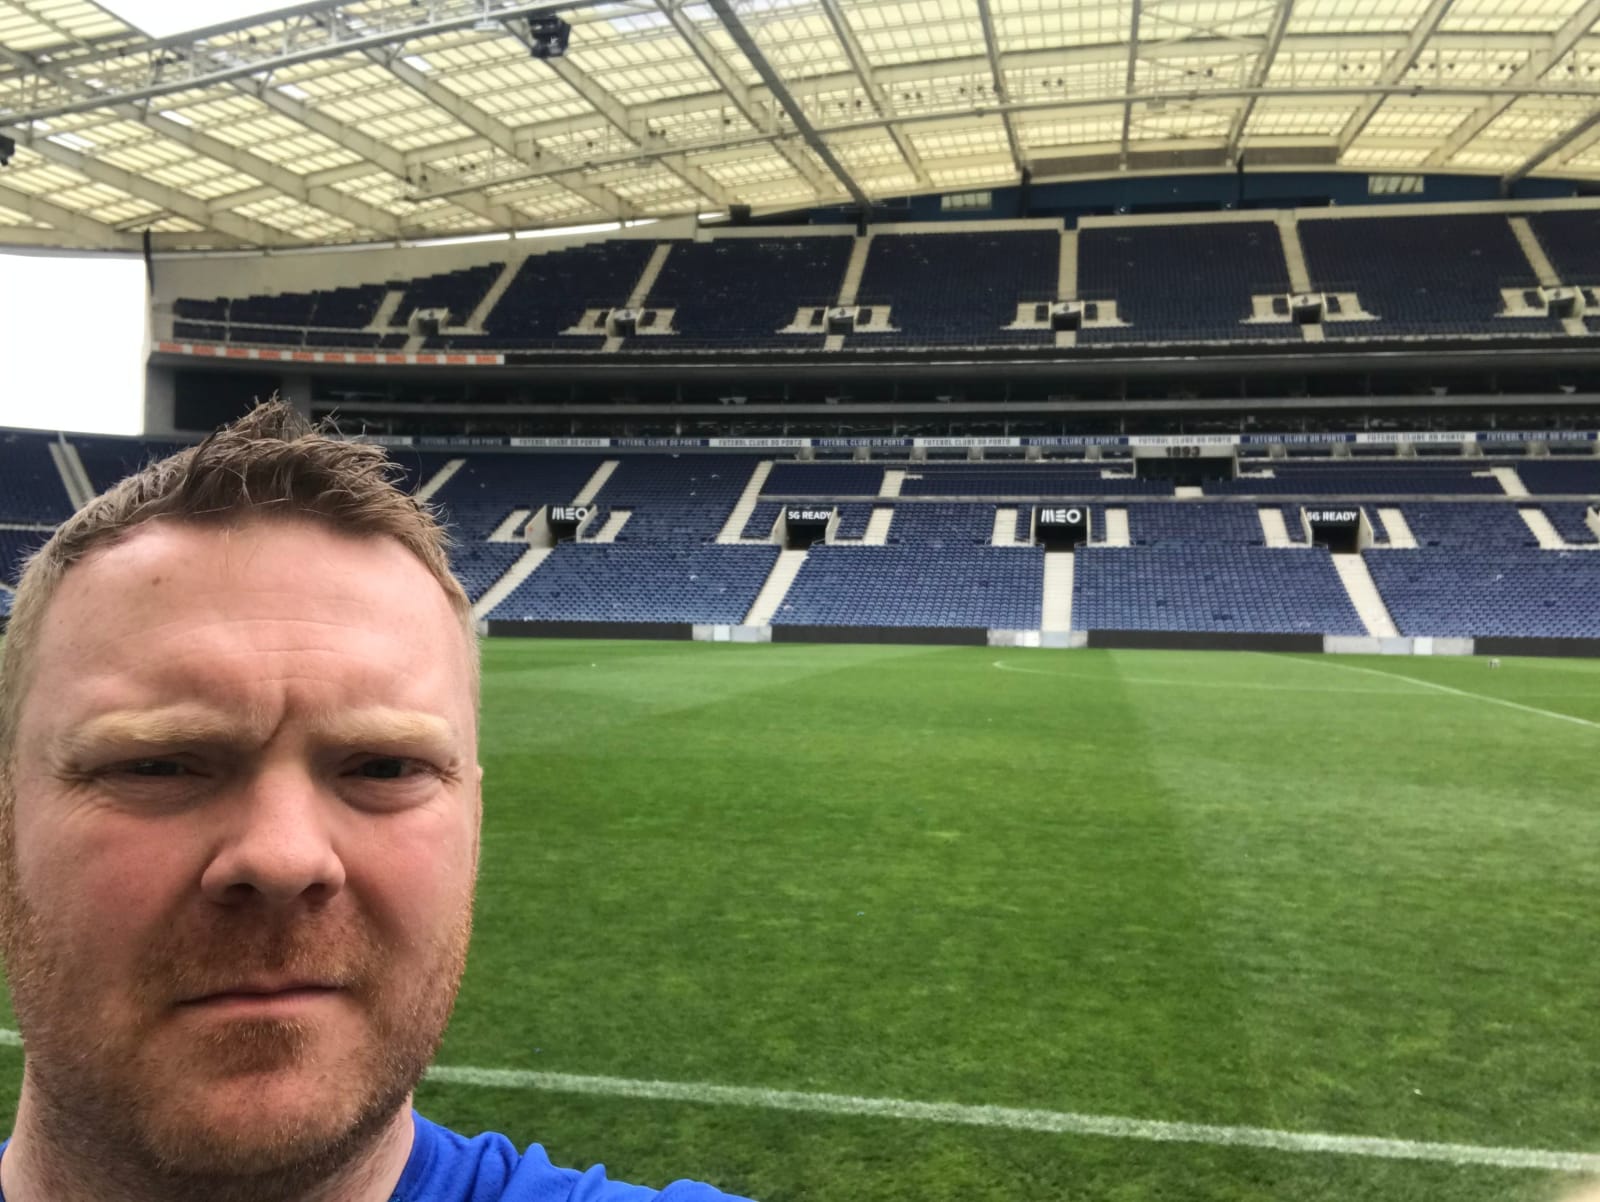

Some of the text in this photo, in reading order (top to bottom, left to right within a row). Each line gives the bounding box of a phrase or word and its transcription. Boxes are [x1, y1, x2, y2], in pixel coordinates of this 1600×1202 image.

[552, 507, 587, 520] MEO
[802, 511, 832, 520] READY
[1041, 509, 1081, 523] MEO
[1322, 511, 1357, 521] READY
